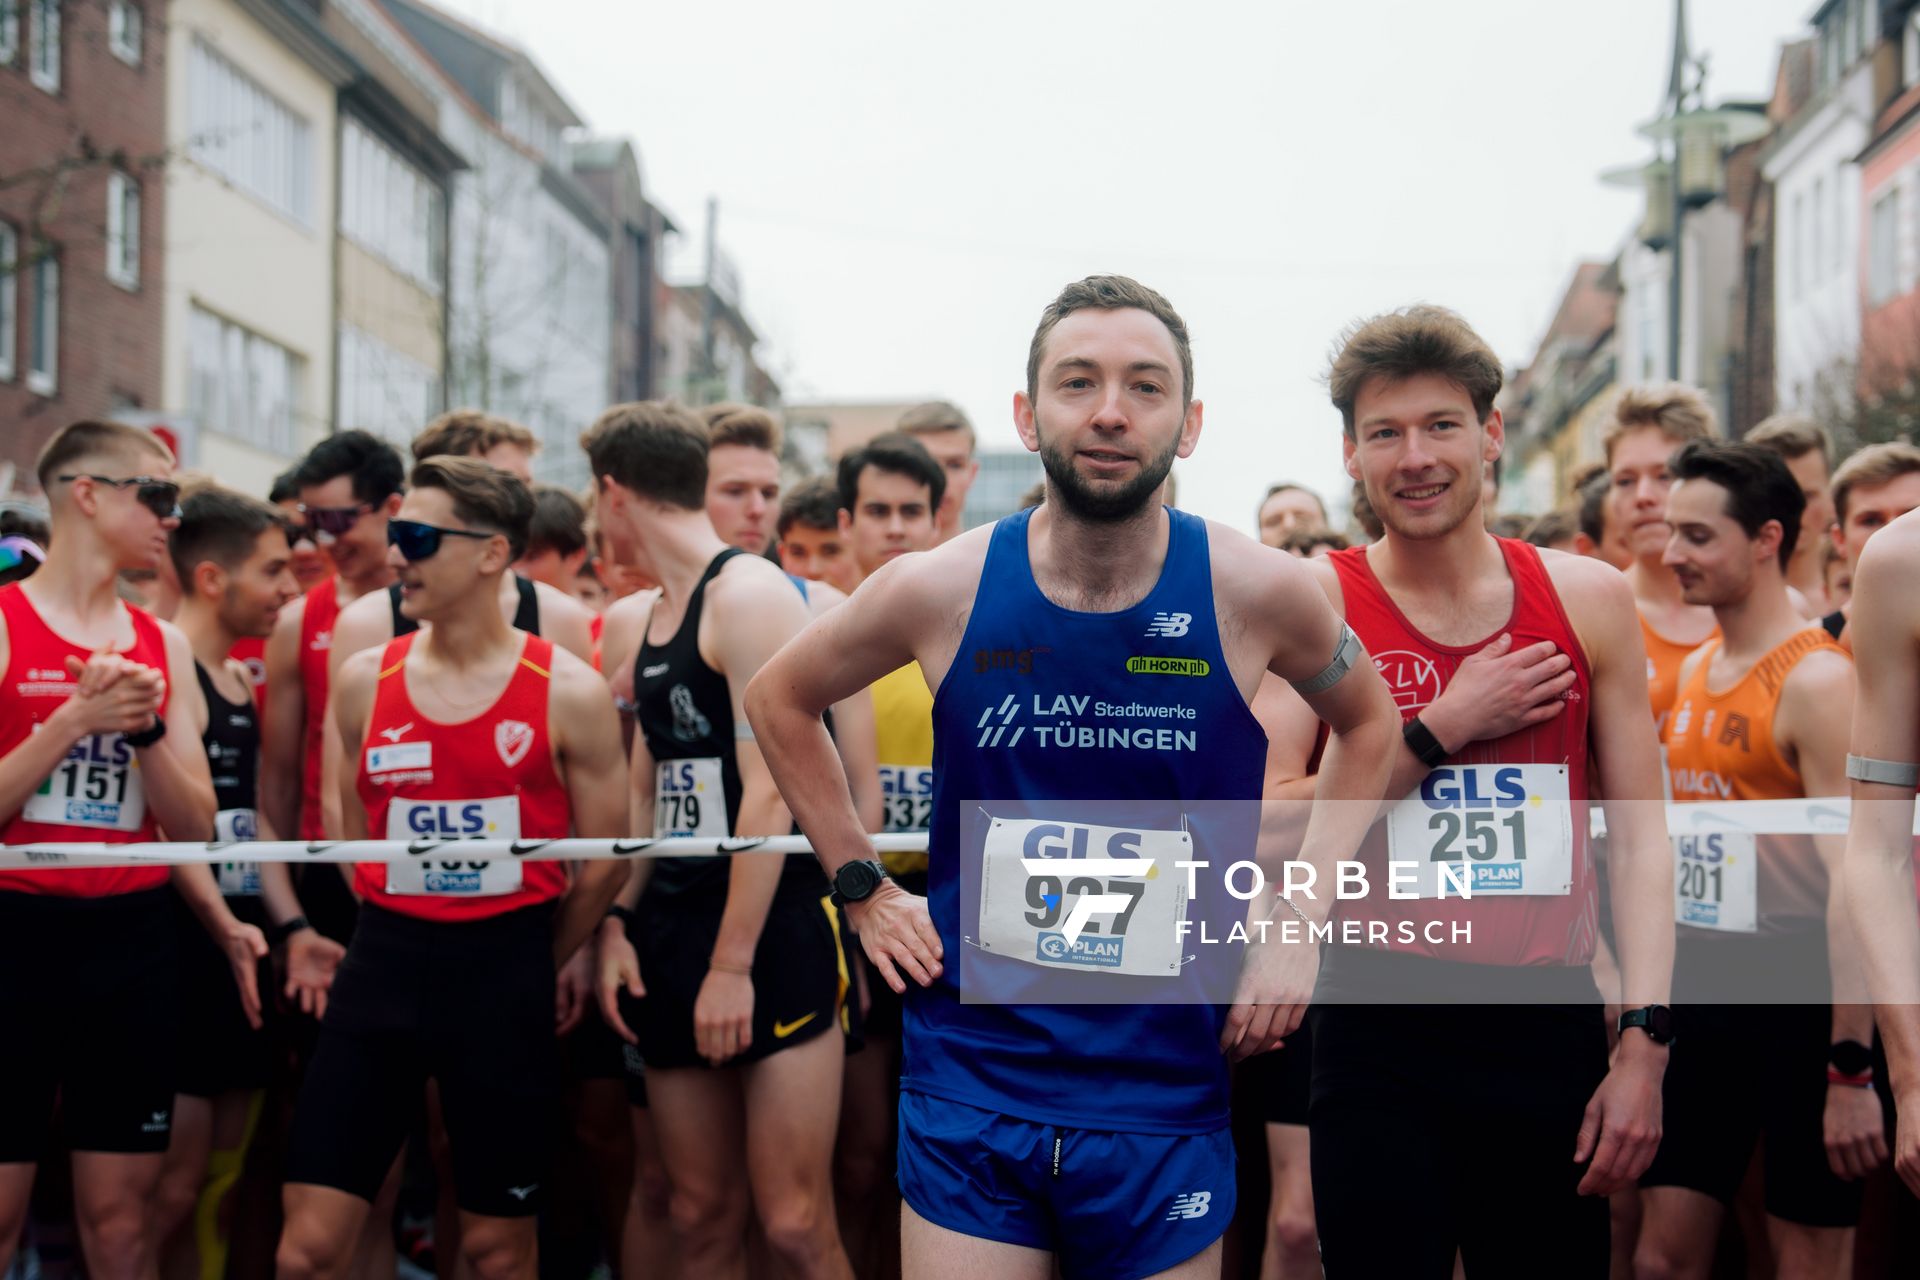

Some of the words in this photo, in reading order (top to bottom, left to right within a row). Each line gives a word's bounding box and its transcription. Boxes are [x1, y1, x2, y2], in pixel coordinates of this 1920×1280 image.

[1149, 661, 1188, 673] HORN
[1034, 695, 1091, 716] LAV
[1094, 702, 1197, 719] Stadtwerke
[1034, 721, 1197, 752] TÜBINGEN
[61, 763, 129, 804] 151
[1428, 811, 1527, 862] 251
[1478, 868, 1520, 880] PLAN
[1680, 861, 1722, 902] 201
[1024, 874, 1146, 935] 927
[1072, 955, 1118, 964] INTERNATIONAL
[1073, 941, 1120, 957] PLAN
